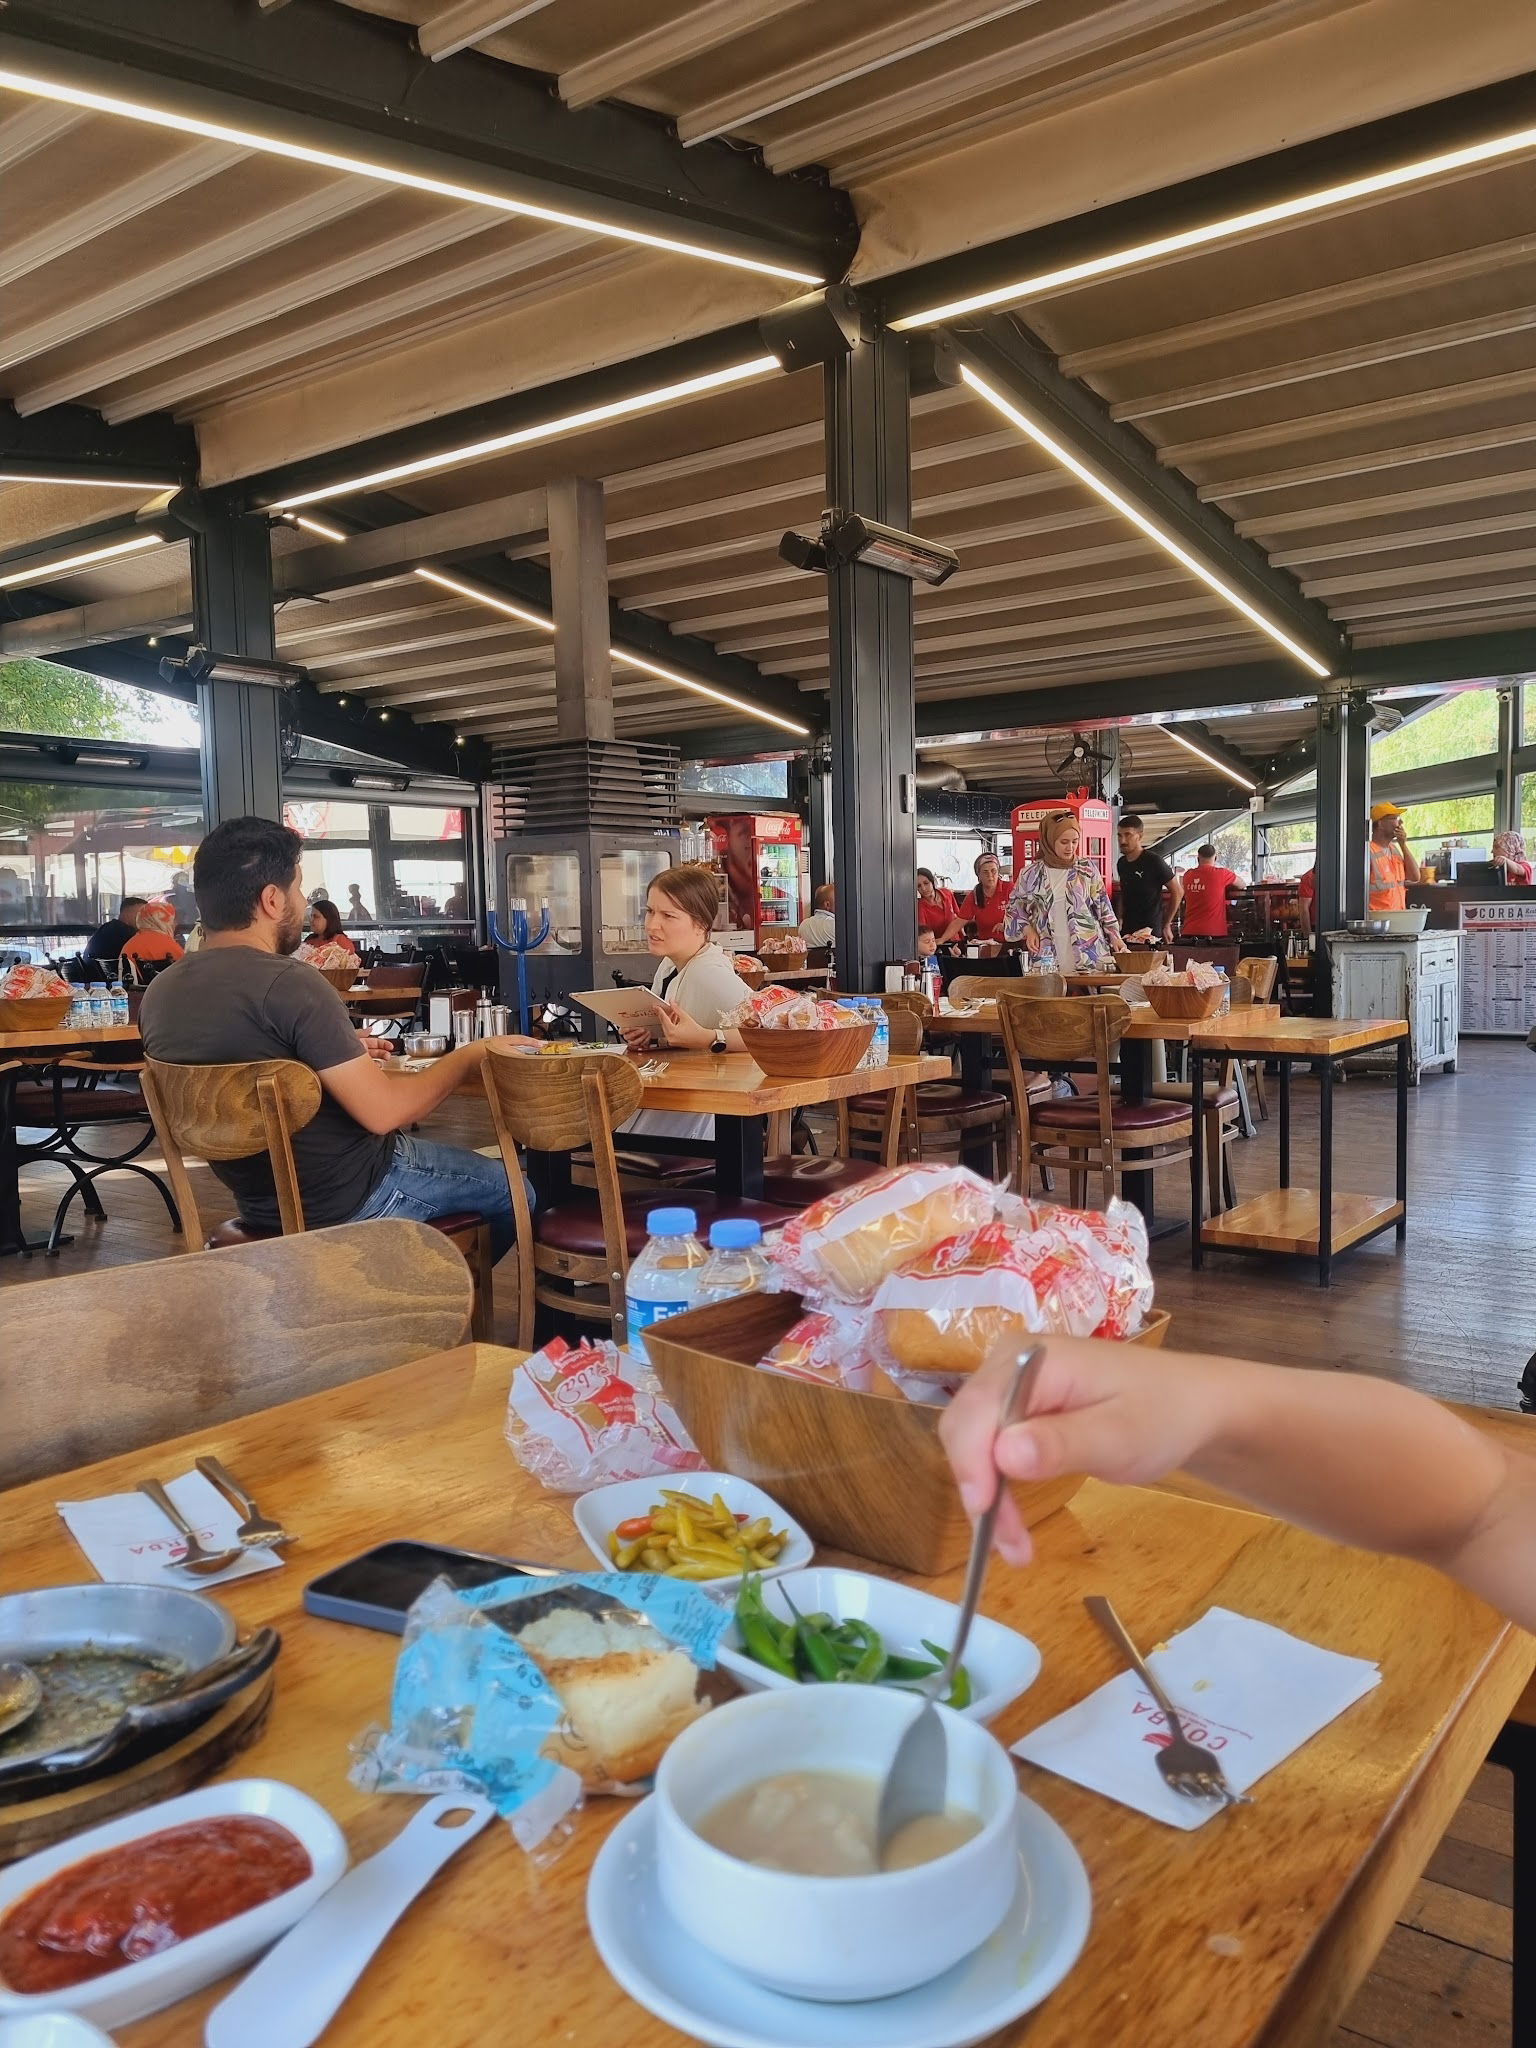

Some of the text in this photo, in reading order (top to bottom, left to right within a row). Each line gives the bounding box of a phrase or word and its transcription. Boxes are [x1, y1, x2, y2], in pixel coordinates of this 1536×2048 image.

[1479, 907, 1523, 918] CORBA
[129, 1530, 214, 1554] CRBA
[1131, 1701, 1228, 1751] COBA
